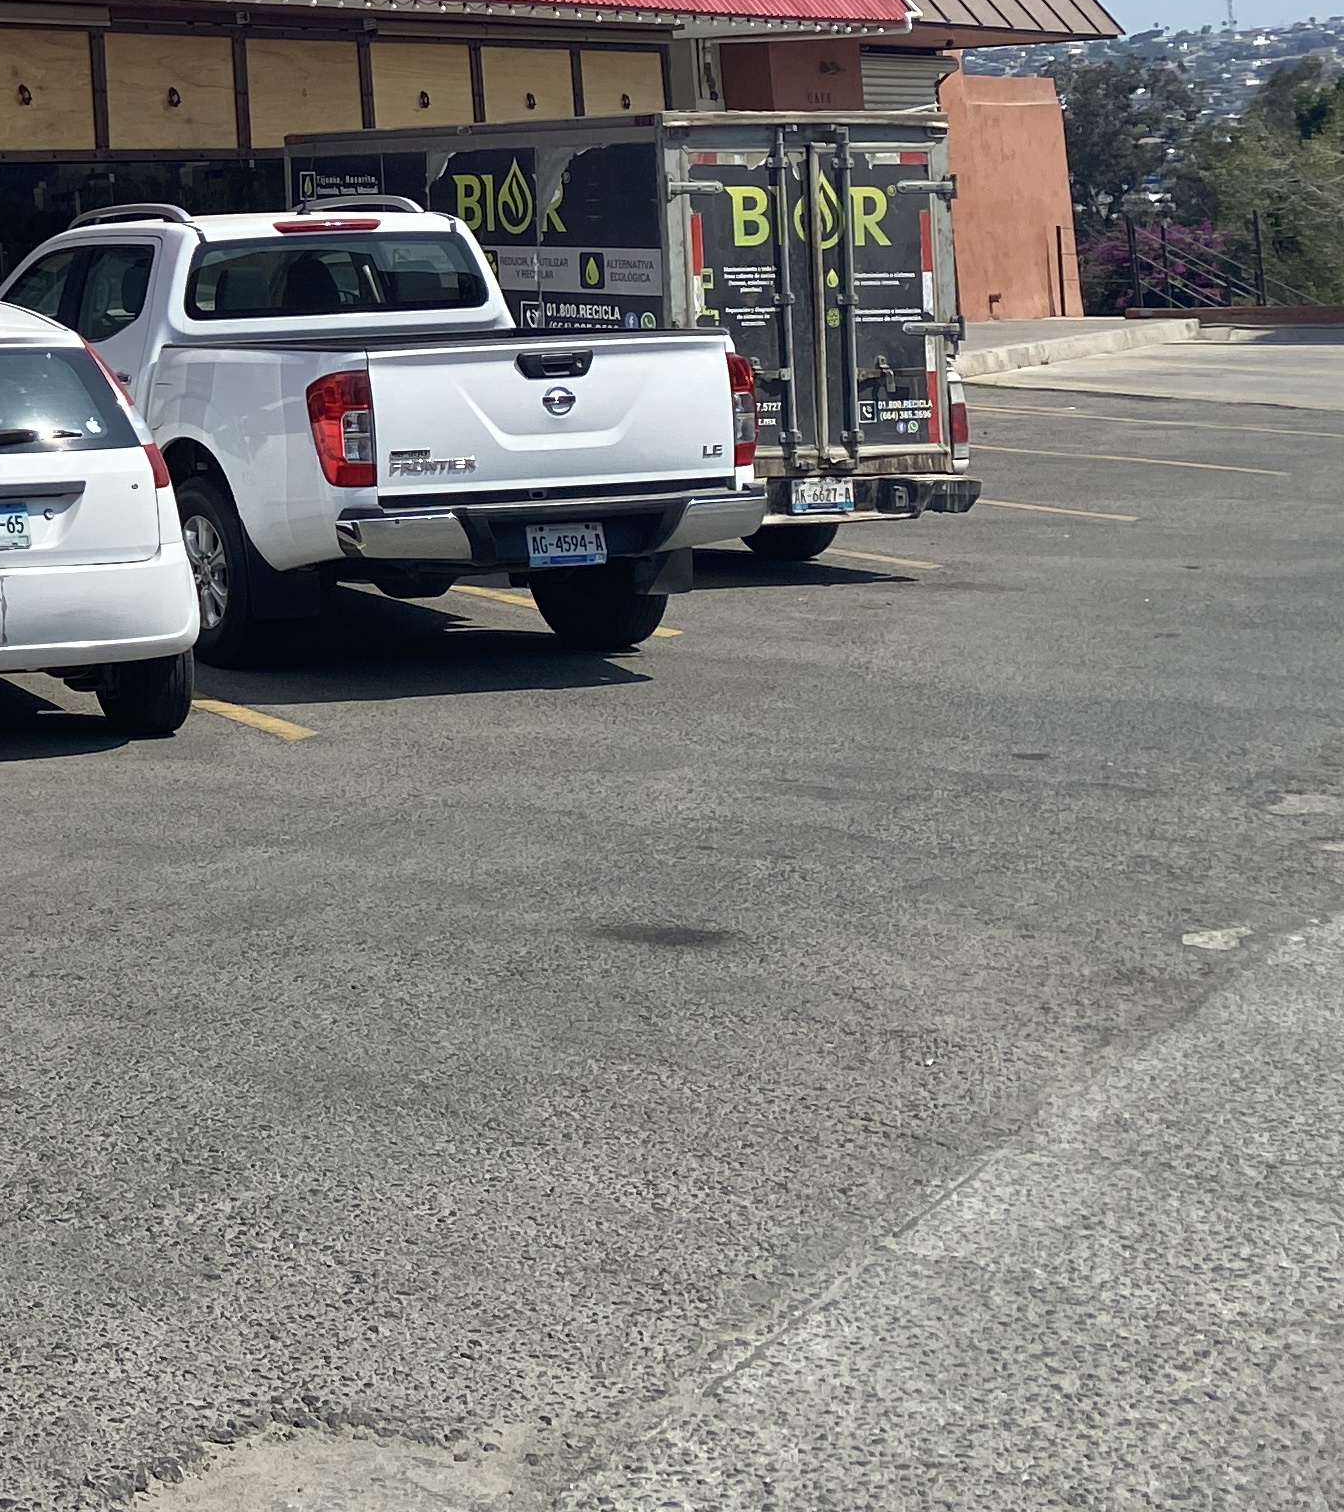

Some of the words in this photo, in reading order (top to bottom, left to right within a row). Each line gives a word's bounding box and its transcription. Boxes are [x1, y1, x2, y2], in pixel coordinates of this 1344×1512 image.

[530, 256, 568, 268] RUTILIZAR
[606, 258, 654, 271] ALTERNATIVA
[521, 269, 554, 280] RECLAR
[609, 270, 651, 283] ECOLÓGICA
[546, 302, 621, 321] 01.800.RECICLA
[702, 442, 724, 459] LE
[389, 456, 477, 477] FRONTIER
[794, 487, 851, 504] AK-6627-A
[531, 533, 604, 555] AG-4594-A
